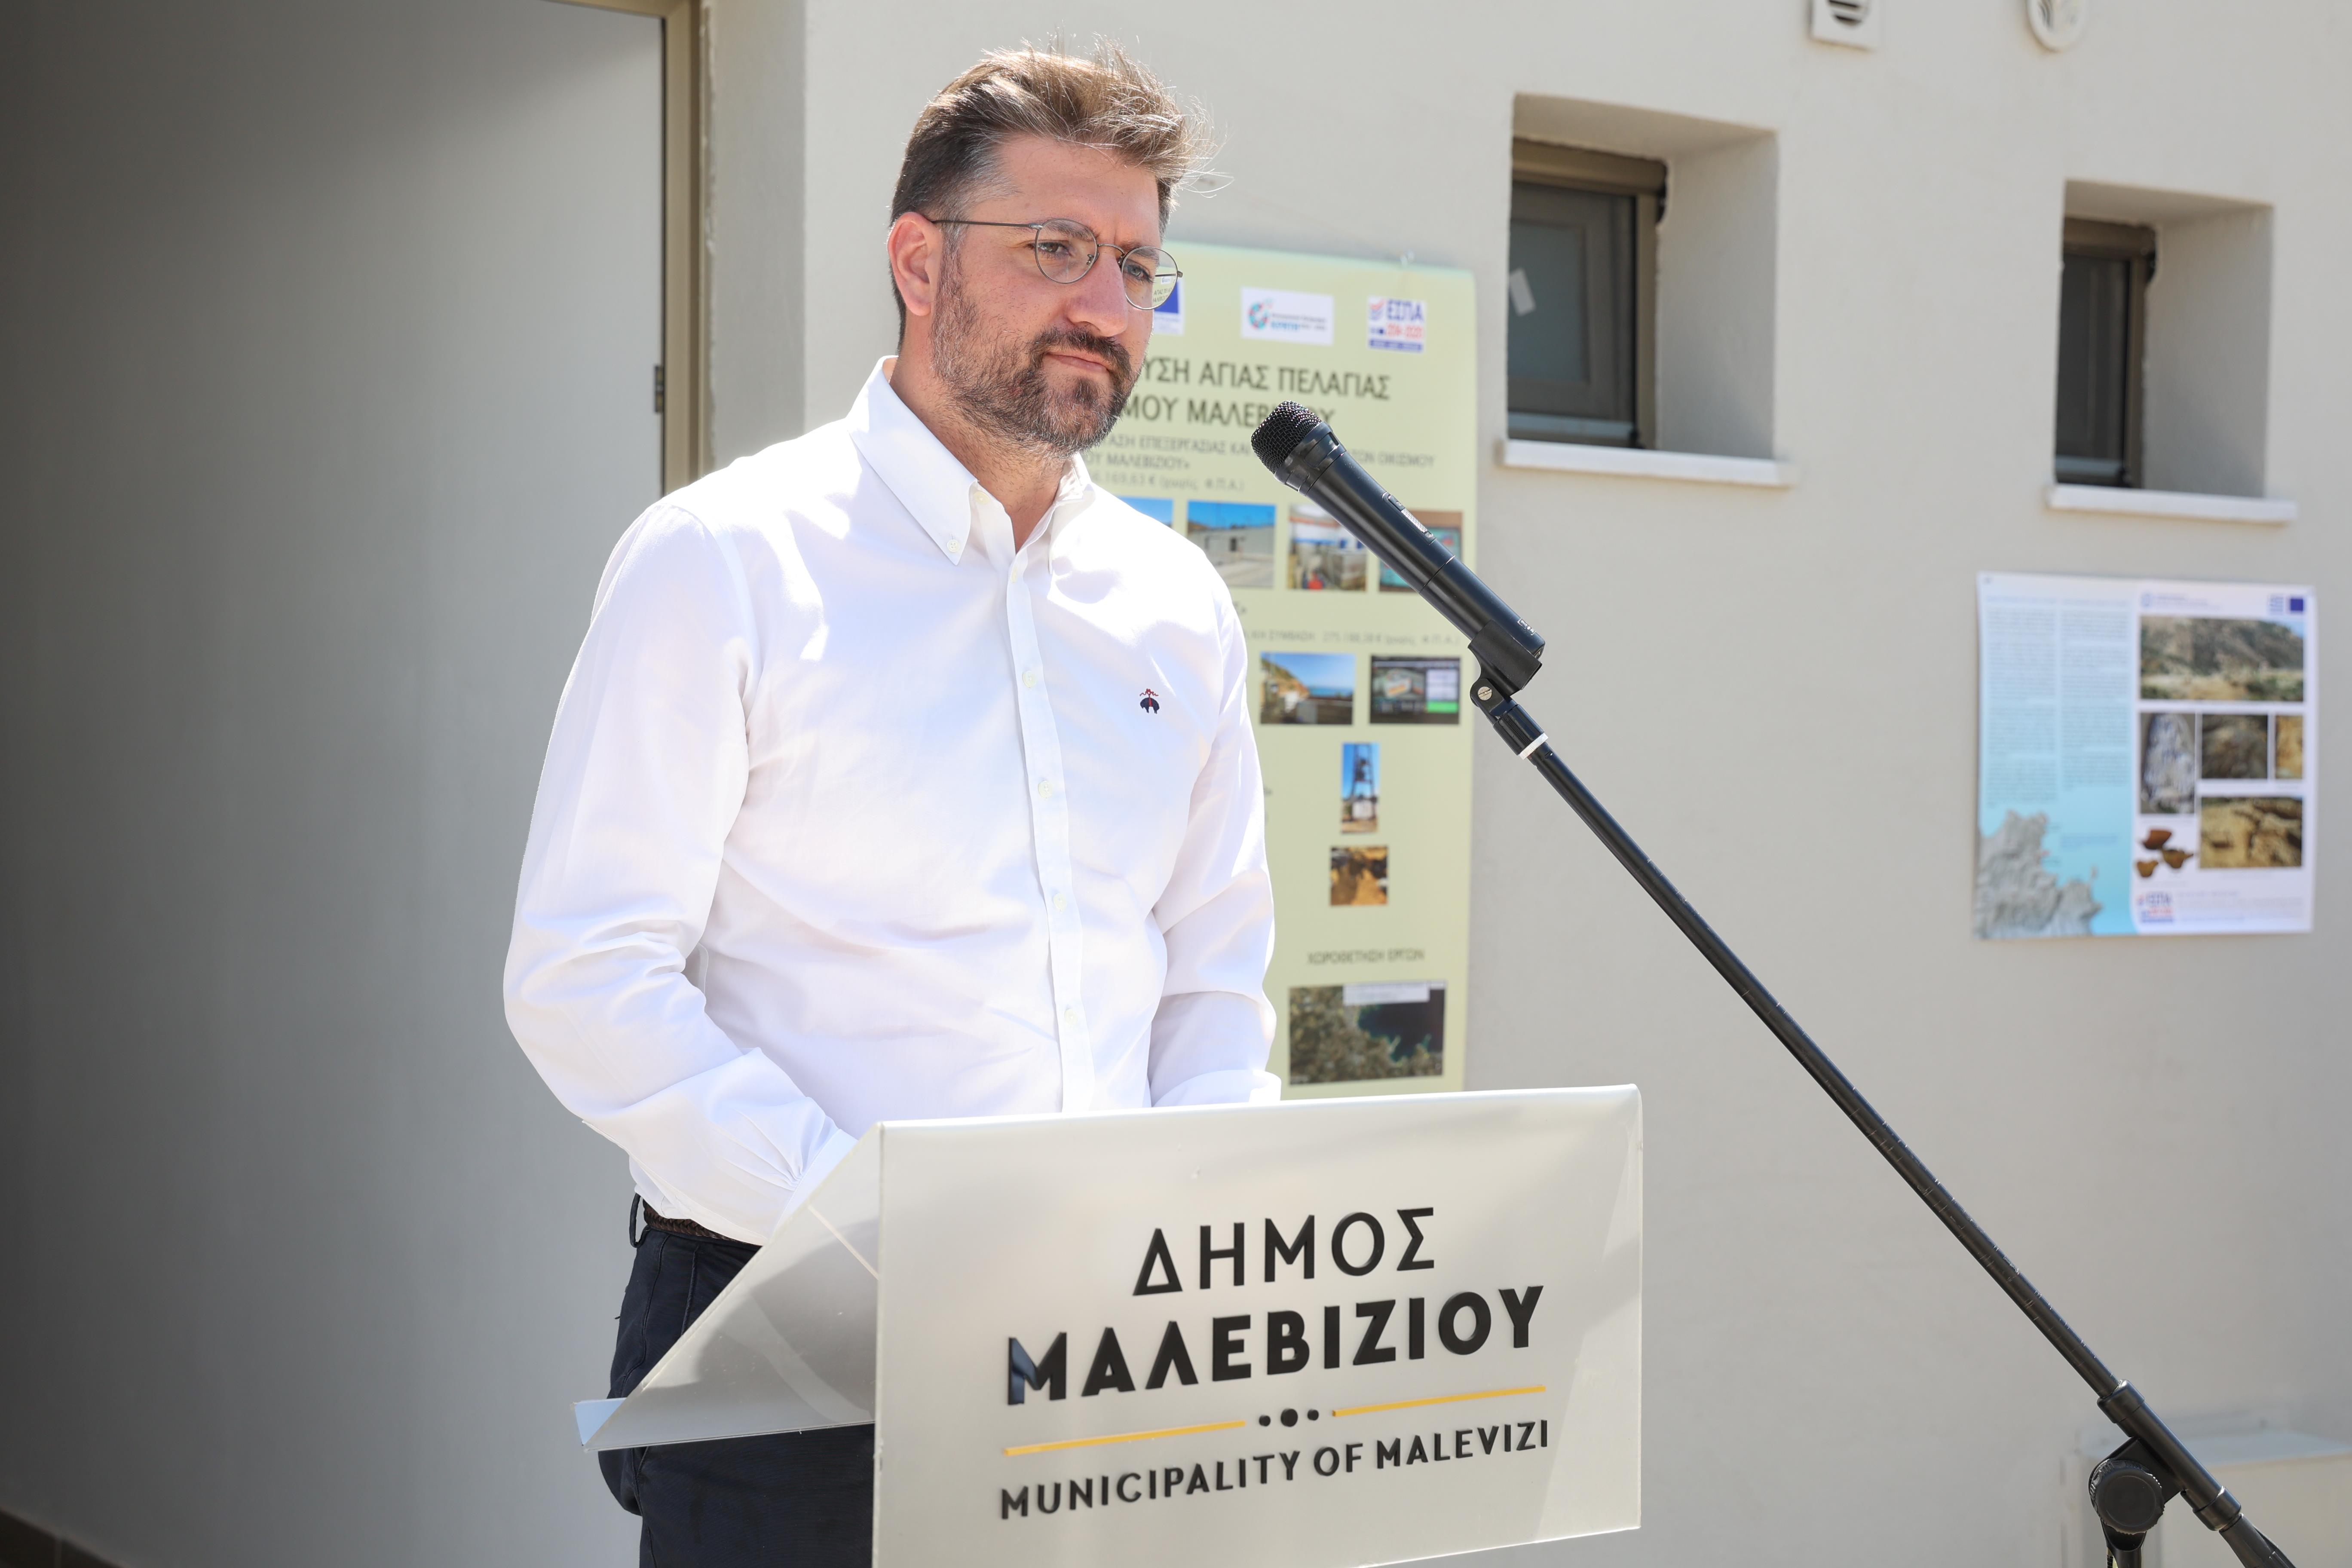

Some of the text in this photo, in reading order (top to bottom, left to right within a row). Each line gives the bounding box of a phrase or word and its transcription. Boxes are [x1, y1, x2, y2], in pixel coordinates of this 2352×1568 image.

[1387, 299, 1424, 322] ΕΣΠΑ
[1143, 357, 1391, 400] ΥΣΗ ΑΓΙΑΣ ΠΕΛΑΓΙΑΣ
[1133, 1207, 1435, 1296] ΔΗΜΟΣ
[1007, 1285, 1544, 1406] ΜΑΛΕΒΙΖΙΟΥ
[1001, 1419, 1548, 1520] MUNICIPALITY OF MALEVIZI
